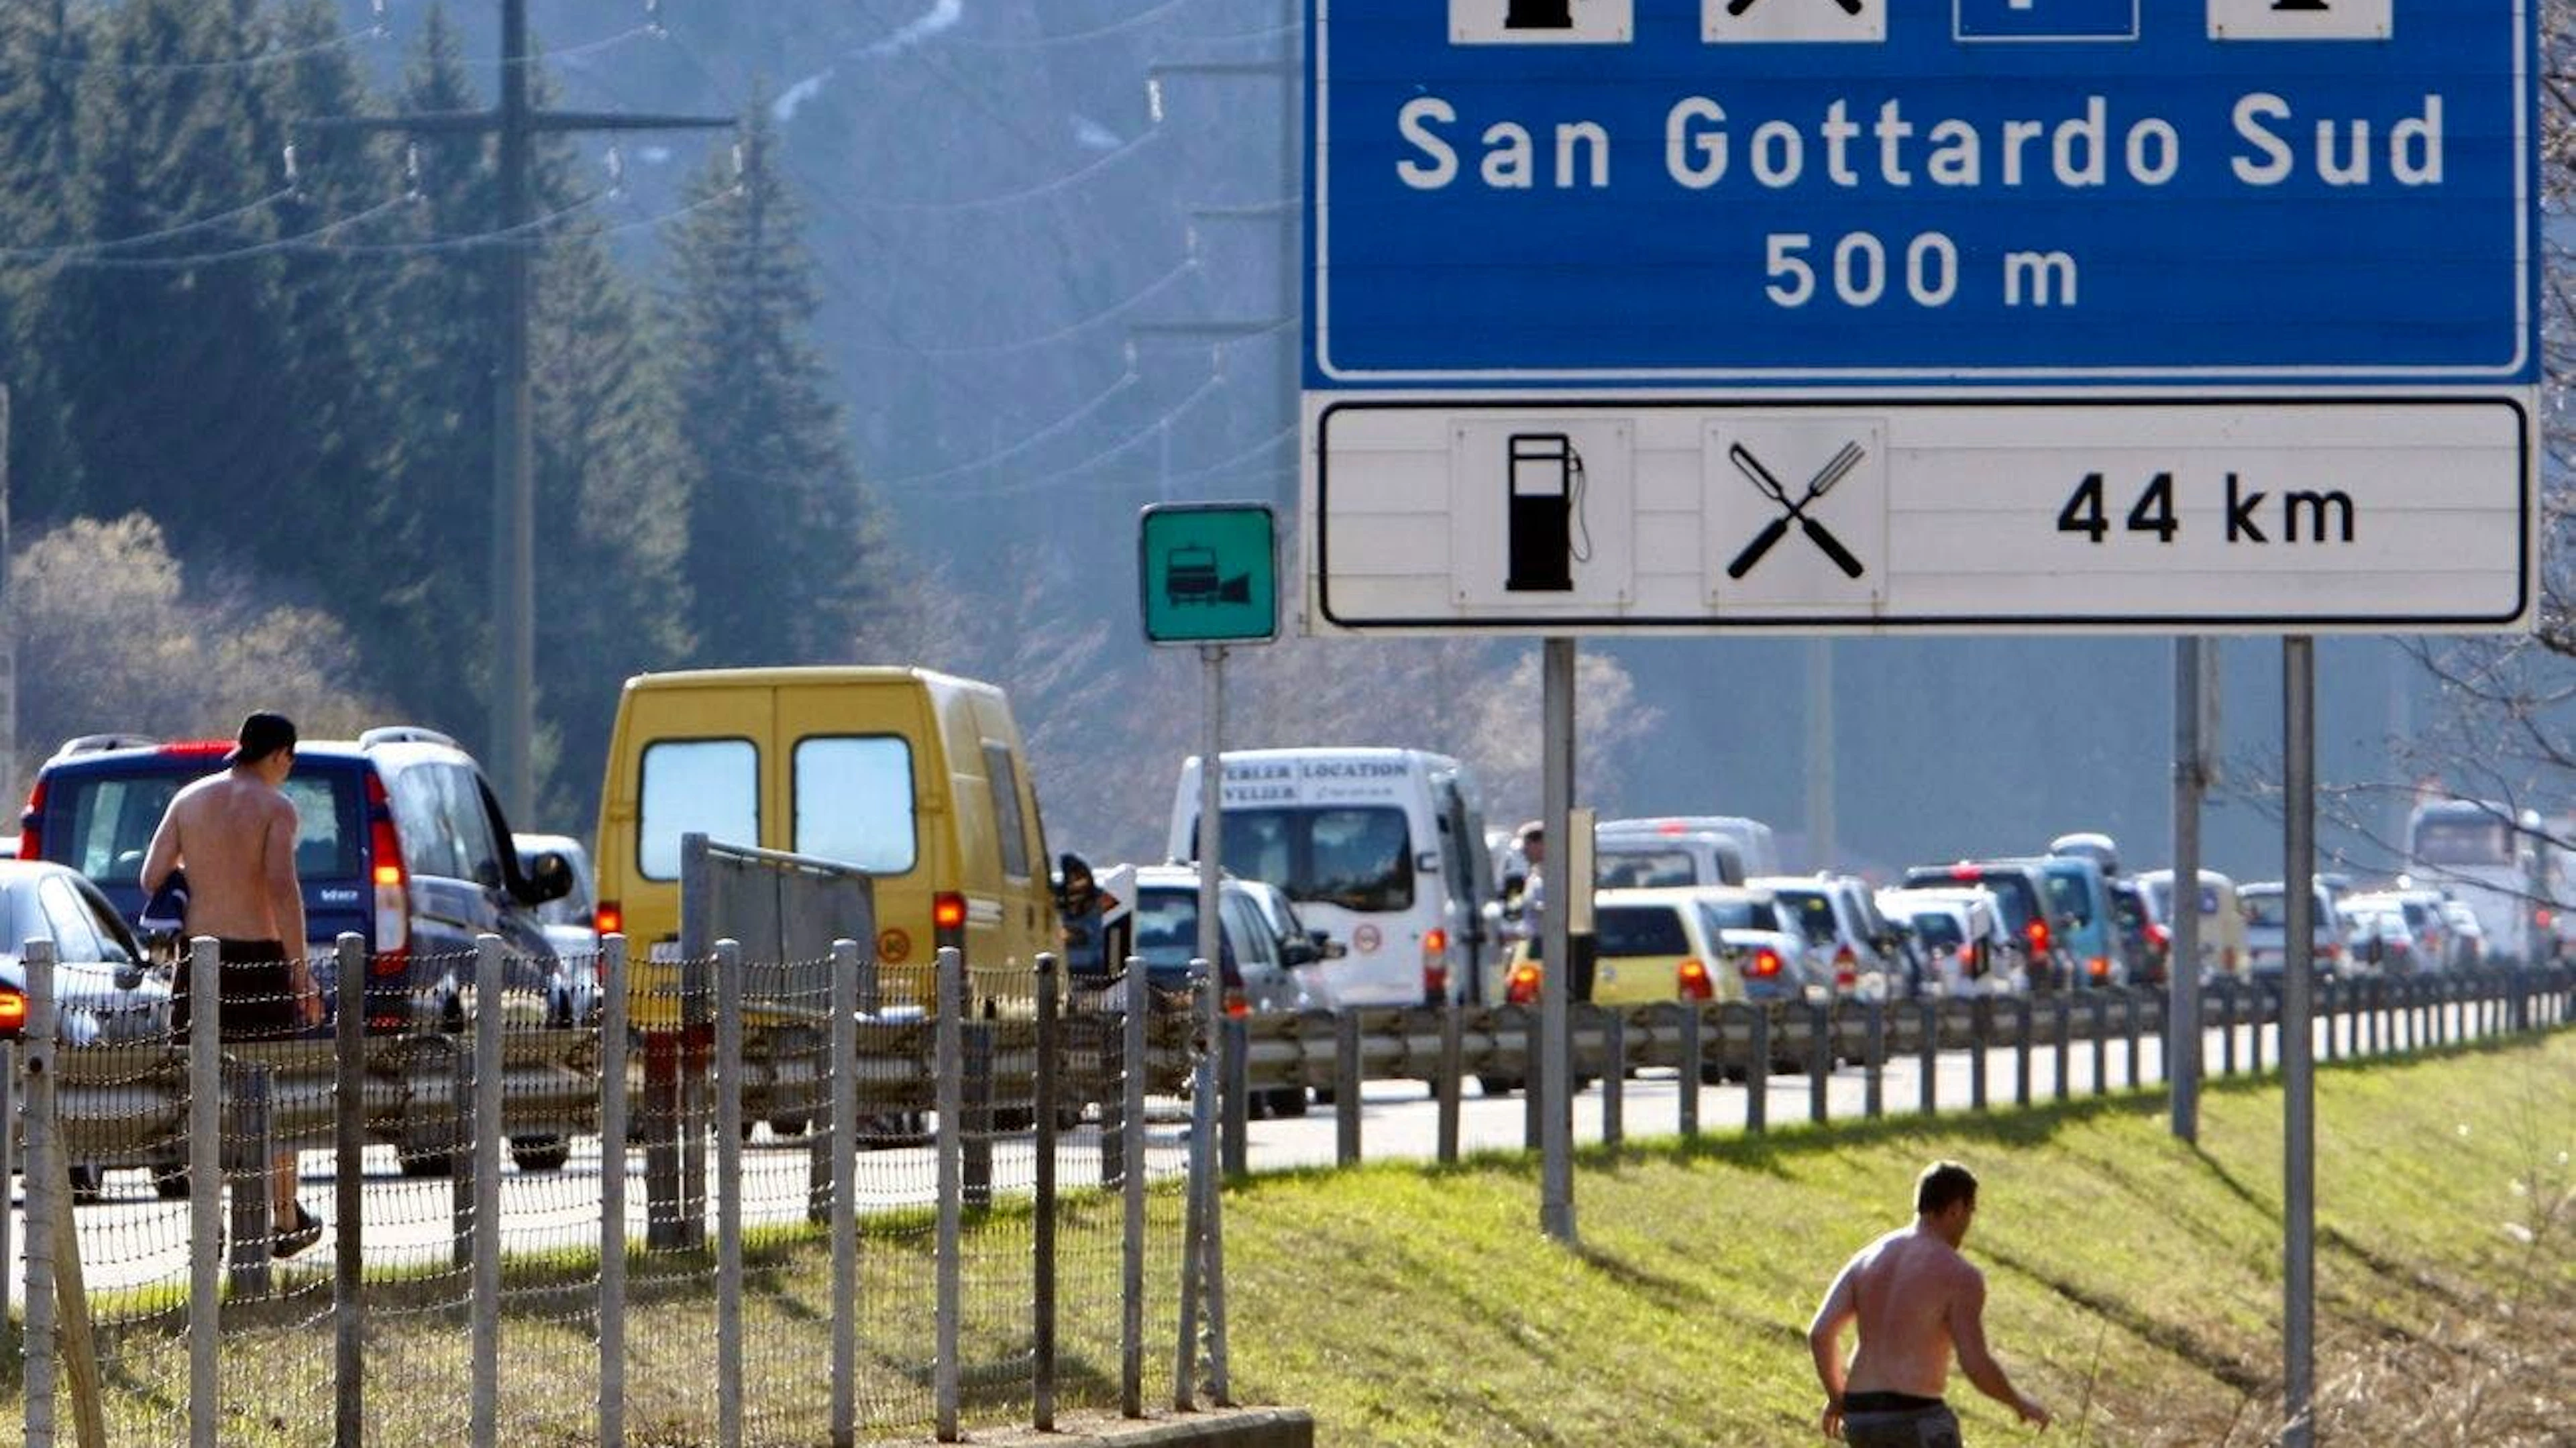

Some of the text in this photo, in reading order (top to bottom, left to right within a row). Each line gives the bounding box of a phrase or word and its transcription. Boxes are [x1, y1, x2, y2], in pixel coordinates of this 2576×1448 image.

[1397, 93, 2443, 188] San Gottardo Sud
[1764, 232, 2076, 309] 500 m
[2057, 471, 2355, 544] 44 km
[1303, 762, 1408, 778] LOCATION
